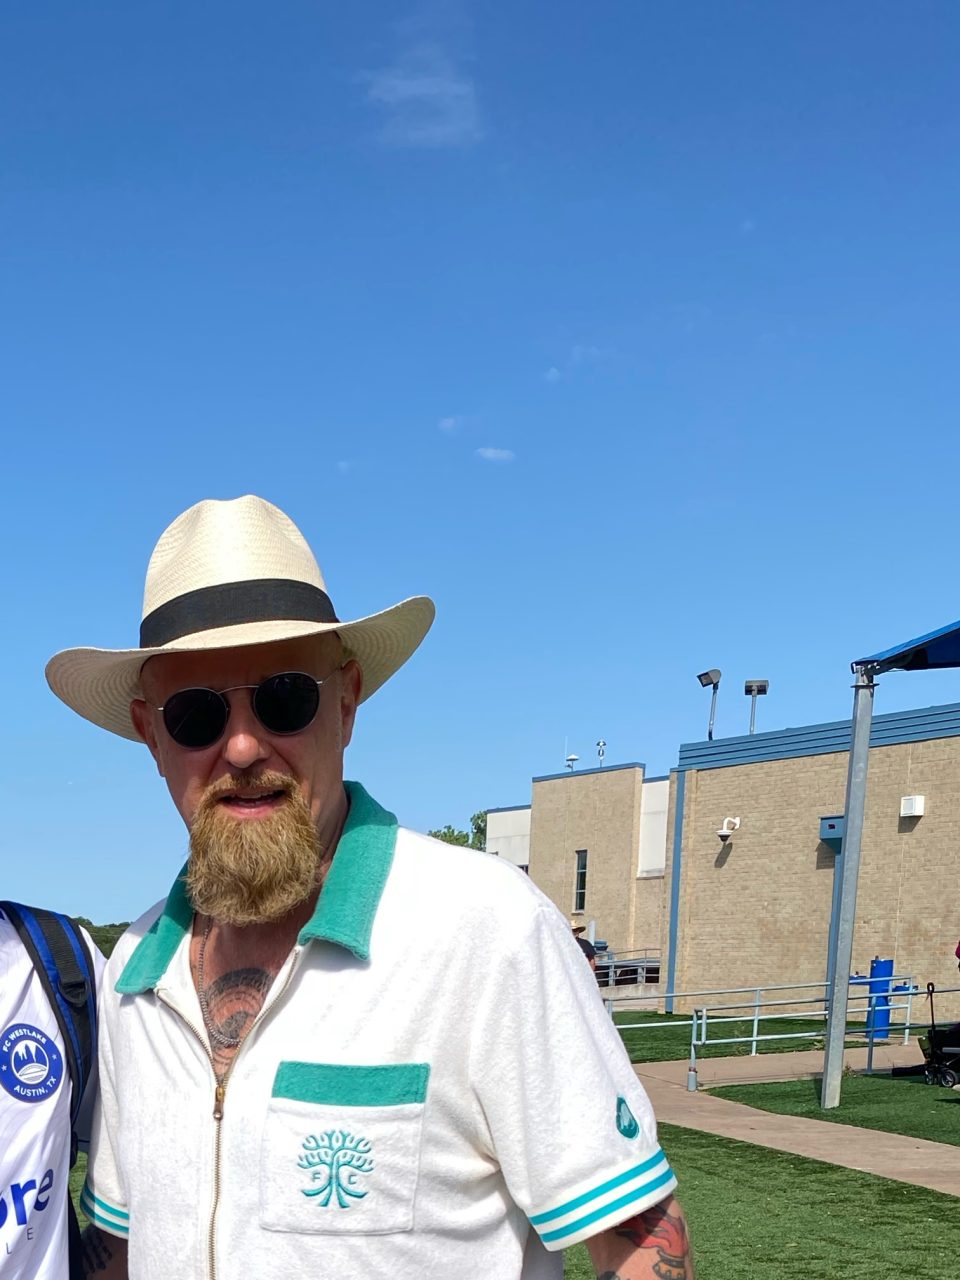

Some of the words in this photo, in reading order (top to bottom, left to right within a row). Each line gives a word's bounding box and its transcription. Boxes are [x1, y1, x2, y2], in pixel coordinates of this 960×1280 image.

[2, 1040, 11, 1053] FC
[9, 1028, 47, 1045] WESTLAKE
[46, 1076, 57, 1087] TX
